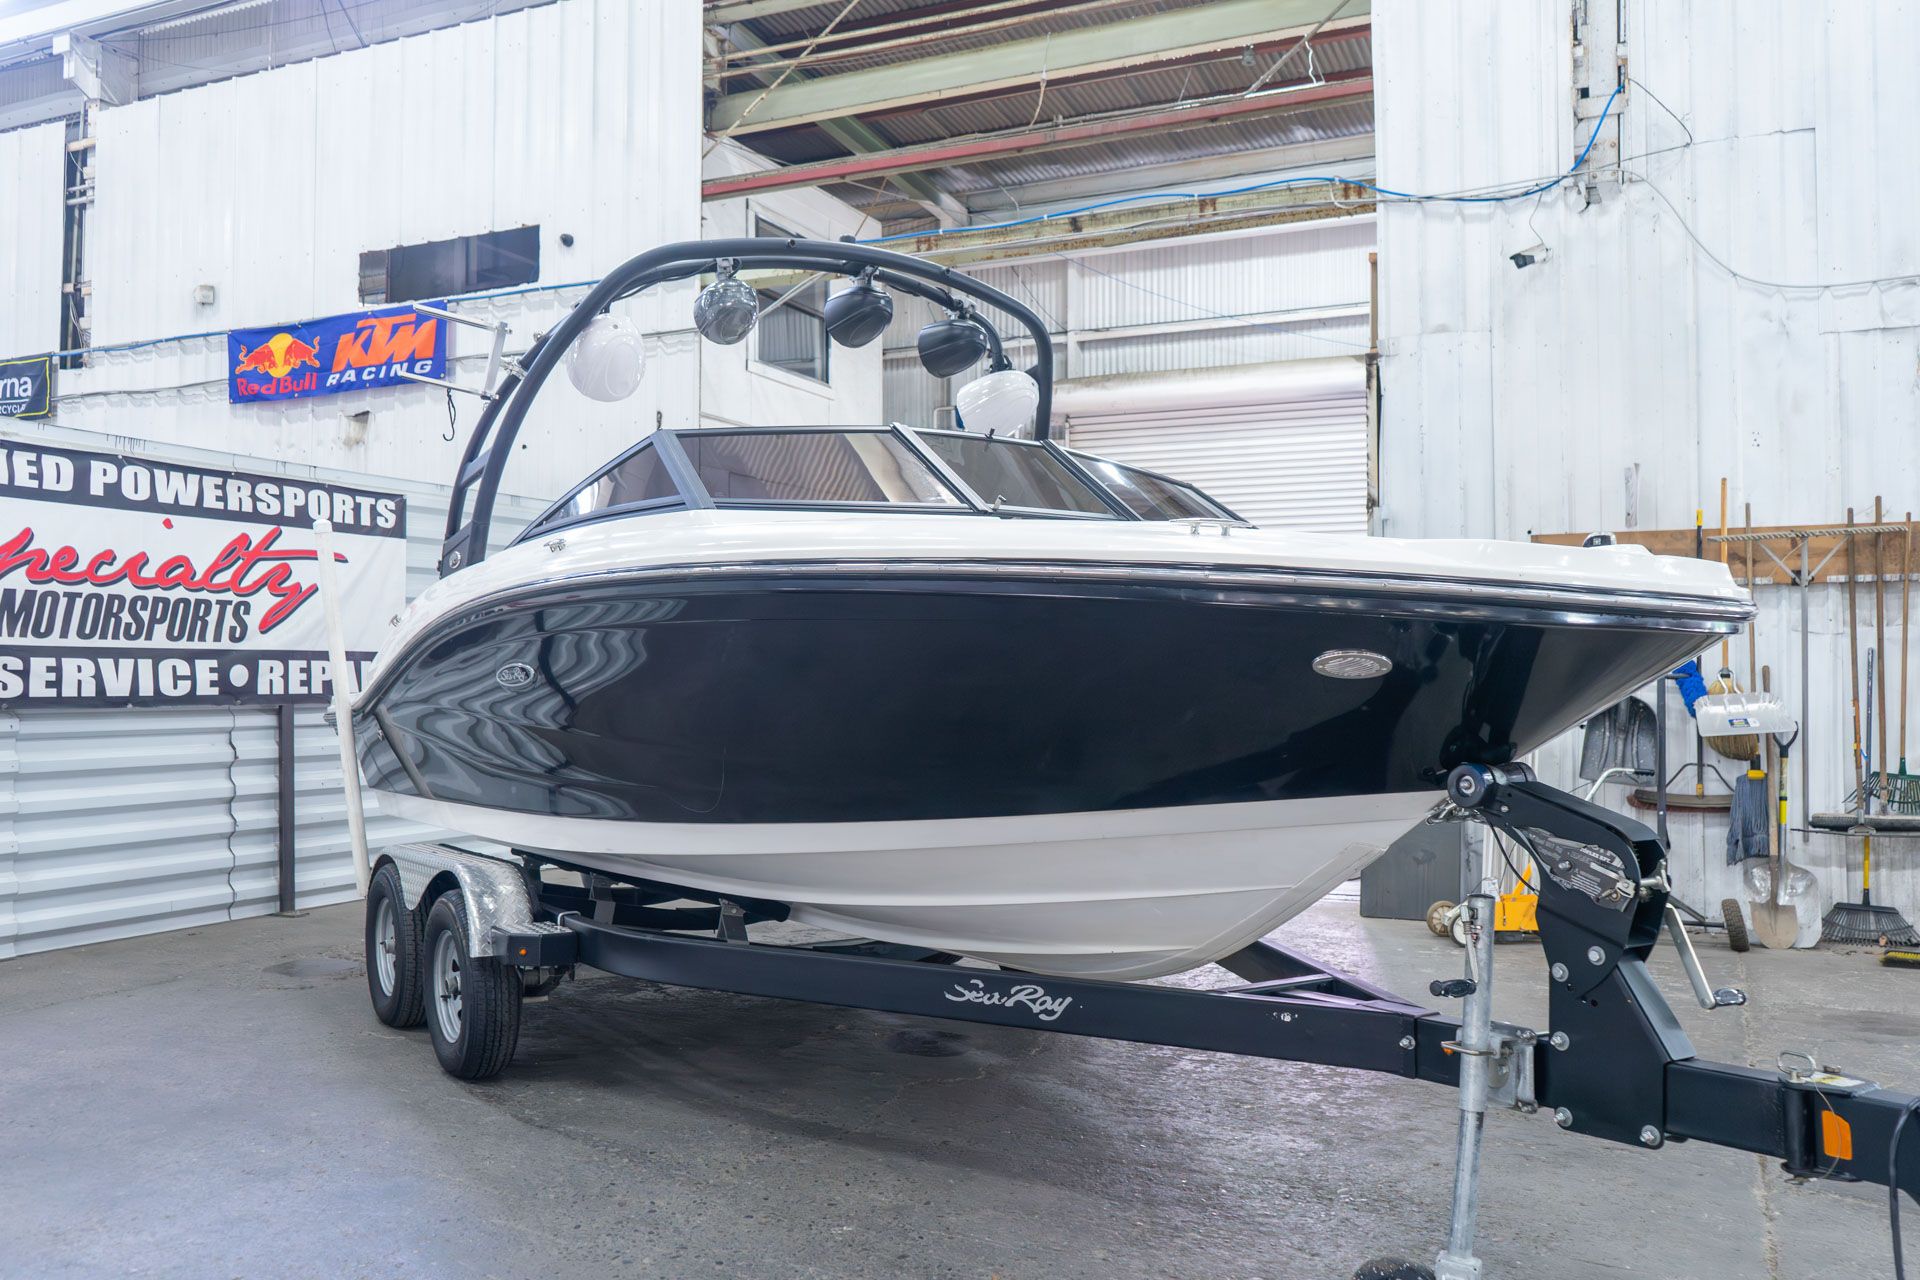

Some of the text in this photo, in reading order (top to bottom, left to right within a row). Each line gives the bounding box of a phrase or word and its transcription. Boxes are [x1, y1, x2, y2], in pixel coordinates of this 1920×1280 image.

[331, 313, 437, 373] KTM
[0, 376, 32, 398] rna
[326, 360, 433, 387] RACING
[90, 460, 397, 529] POWERSPORTS
[0, 588, 251, 643] MOTORSPORTS
[0, 656, 219, 698] SERVICE
[1005, 985, 1073, 1021] Ray
